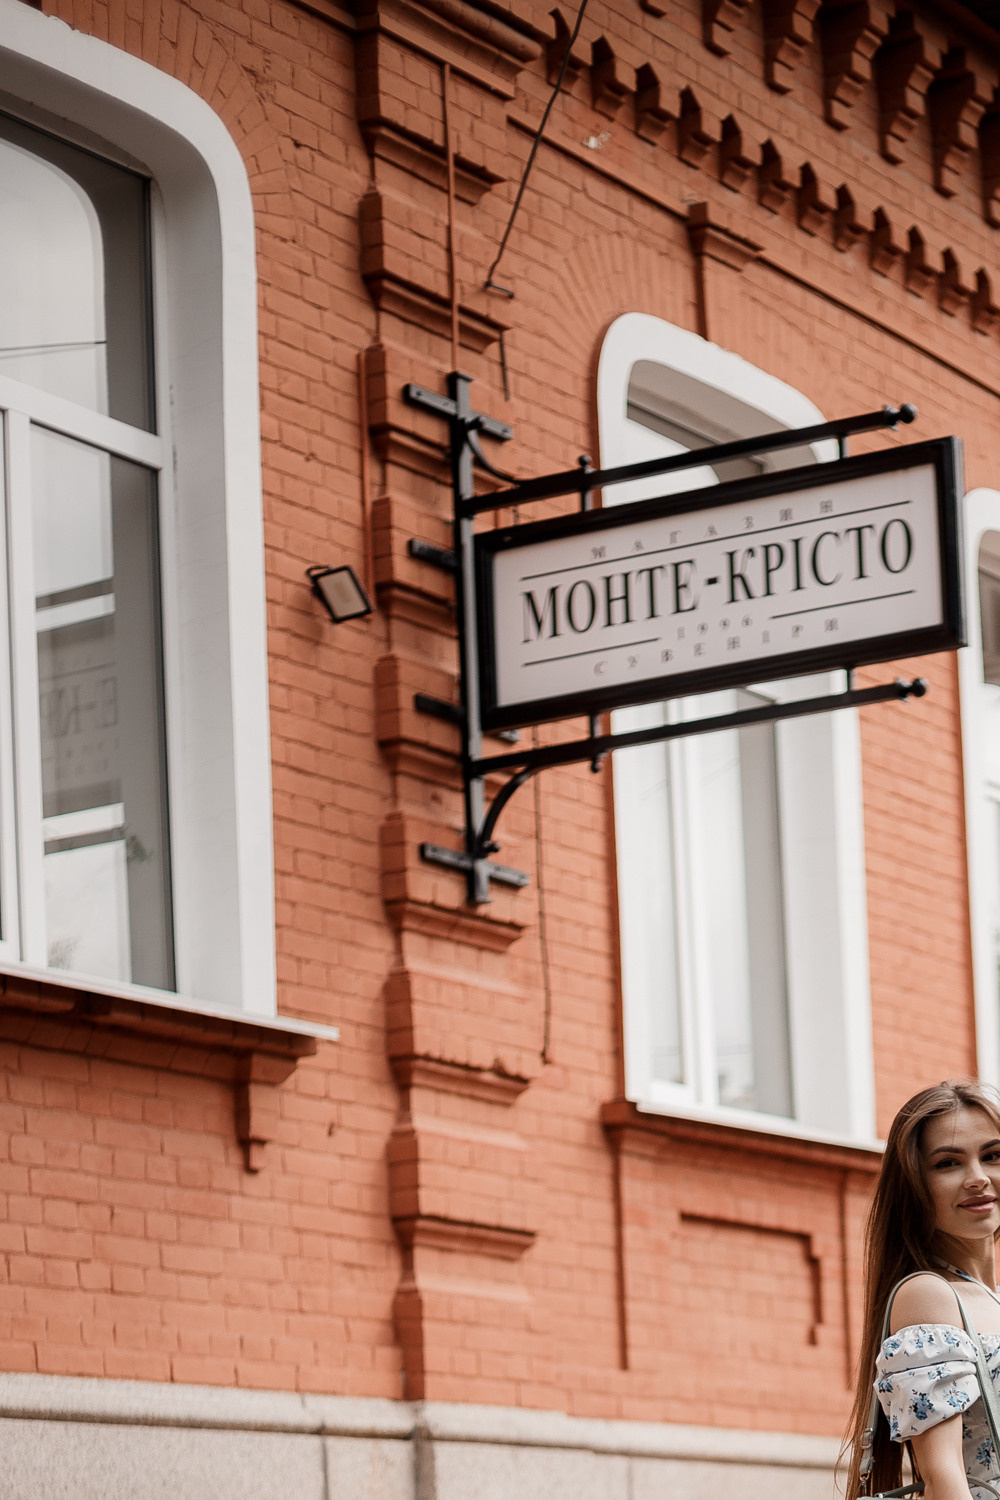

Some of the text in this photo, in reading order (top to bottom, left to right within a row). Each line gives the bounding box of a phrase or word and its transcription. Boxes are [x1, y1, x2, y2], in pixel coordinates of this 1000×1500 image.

[590, 499, 834, 561] МАГАЗИН
[521, 518, 913, 644] МОНТЕ-КРІСТО
[592, 616, 840, 677] СУВЕНІРИ
[676, 614, 753, 641] 1996
